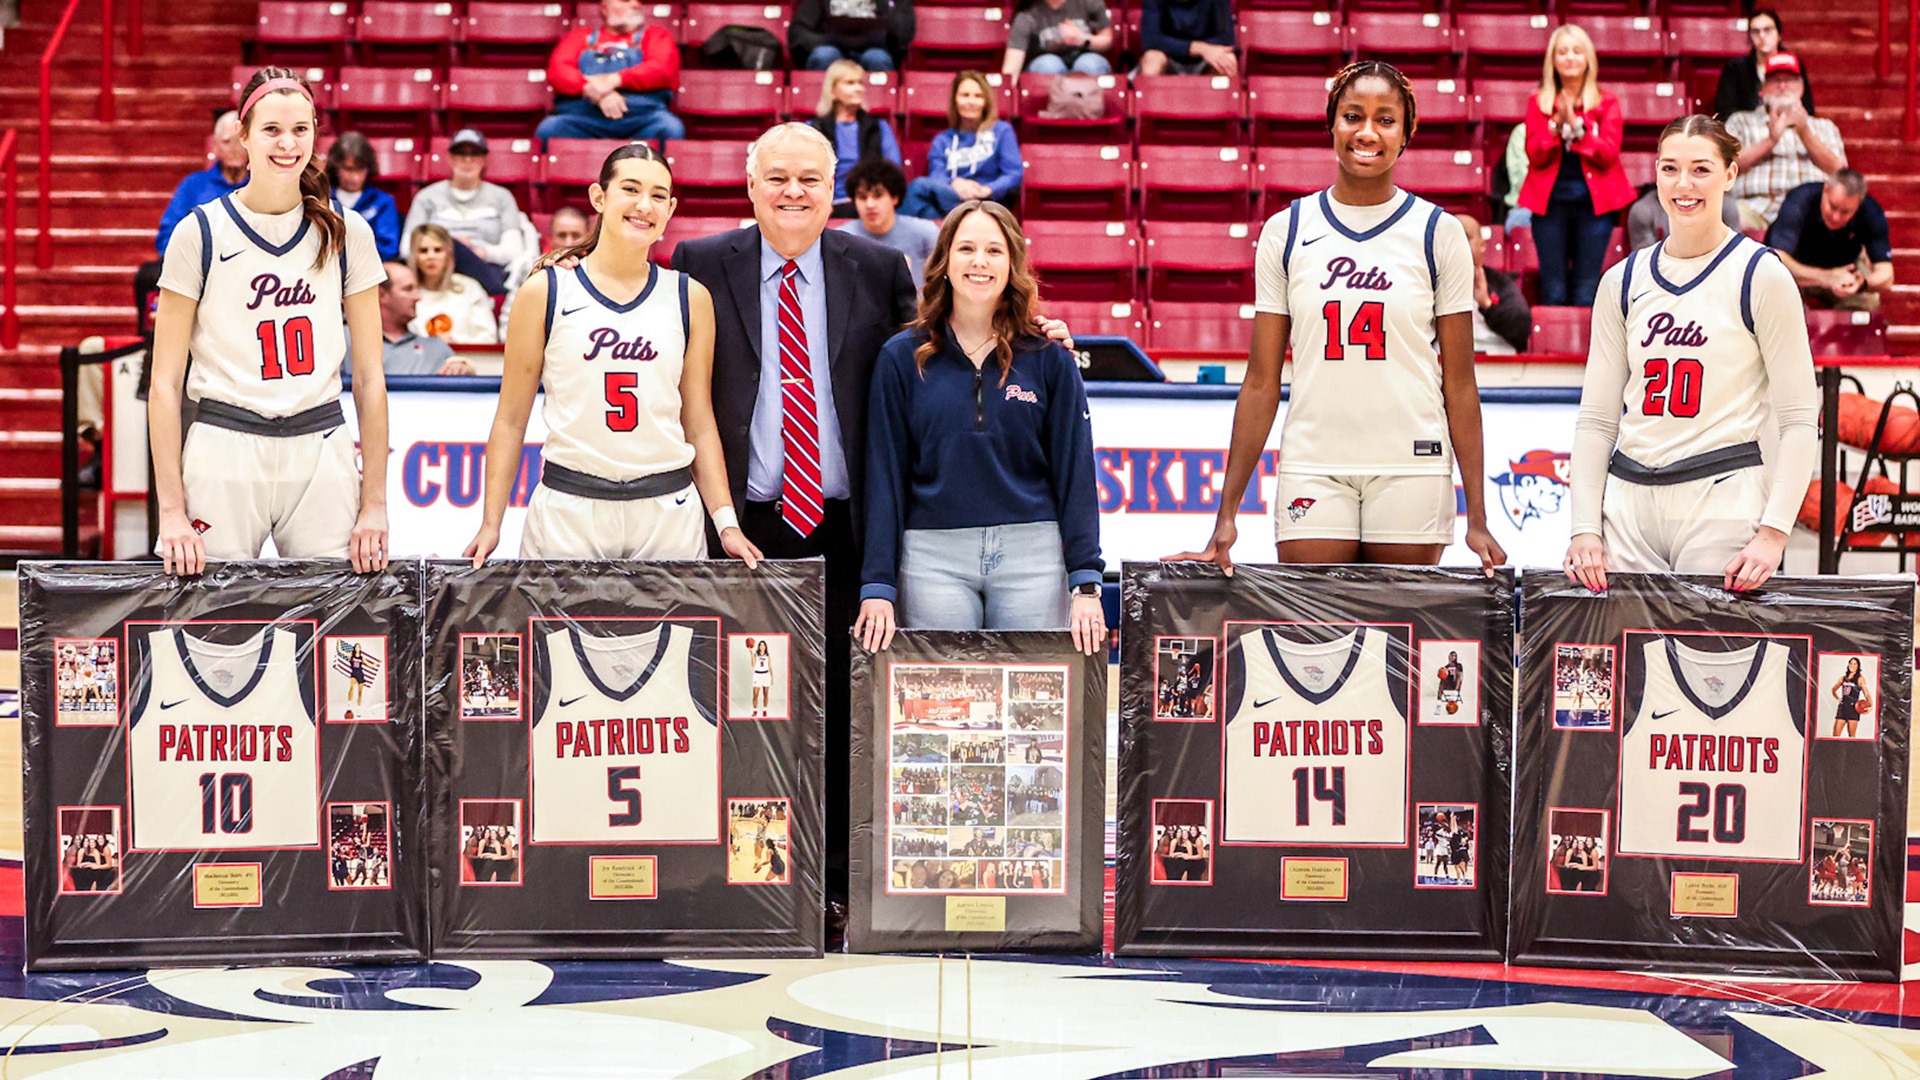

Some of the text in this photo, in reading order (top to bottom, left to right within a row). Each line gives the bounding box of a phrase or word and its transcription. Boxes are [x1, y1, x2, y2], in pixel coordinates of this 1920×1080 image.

[246, 273, 316, 310] Pats
[1319, 256, 1393, 291] Pats
[257, 316, 315, 380] 10
[583, 327, 658, 362] Pats
[1323, 300, 1386, 360] 14
[1640, 312, 1707, 348] Pats
[604, 372, 639, 432] 5
[1005, 384, 1038, 404] Pats
[1641, 358, 1704, 418] 20
[158, 724, 293, 762] PATRIOTS
[555, 717, 690, 759] PATRIOTS
[1253, 719, 1384, 757] PATRIOTS
[1650, 733, 1779, 774] PATRIOTS
[198, 772, 254, 834] 10
[607, 766, 642, 828] 5
[1292, 766, 1346, 826] 14
[1677, 782, 1746, 844] 20
